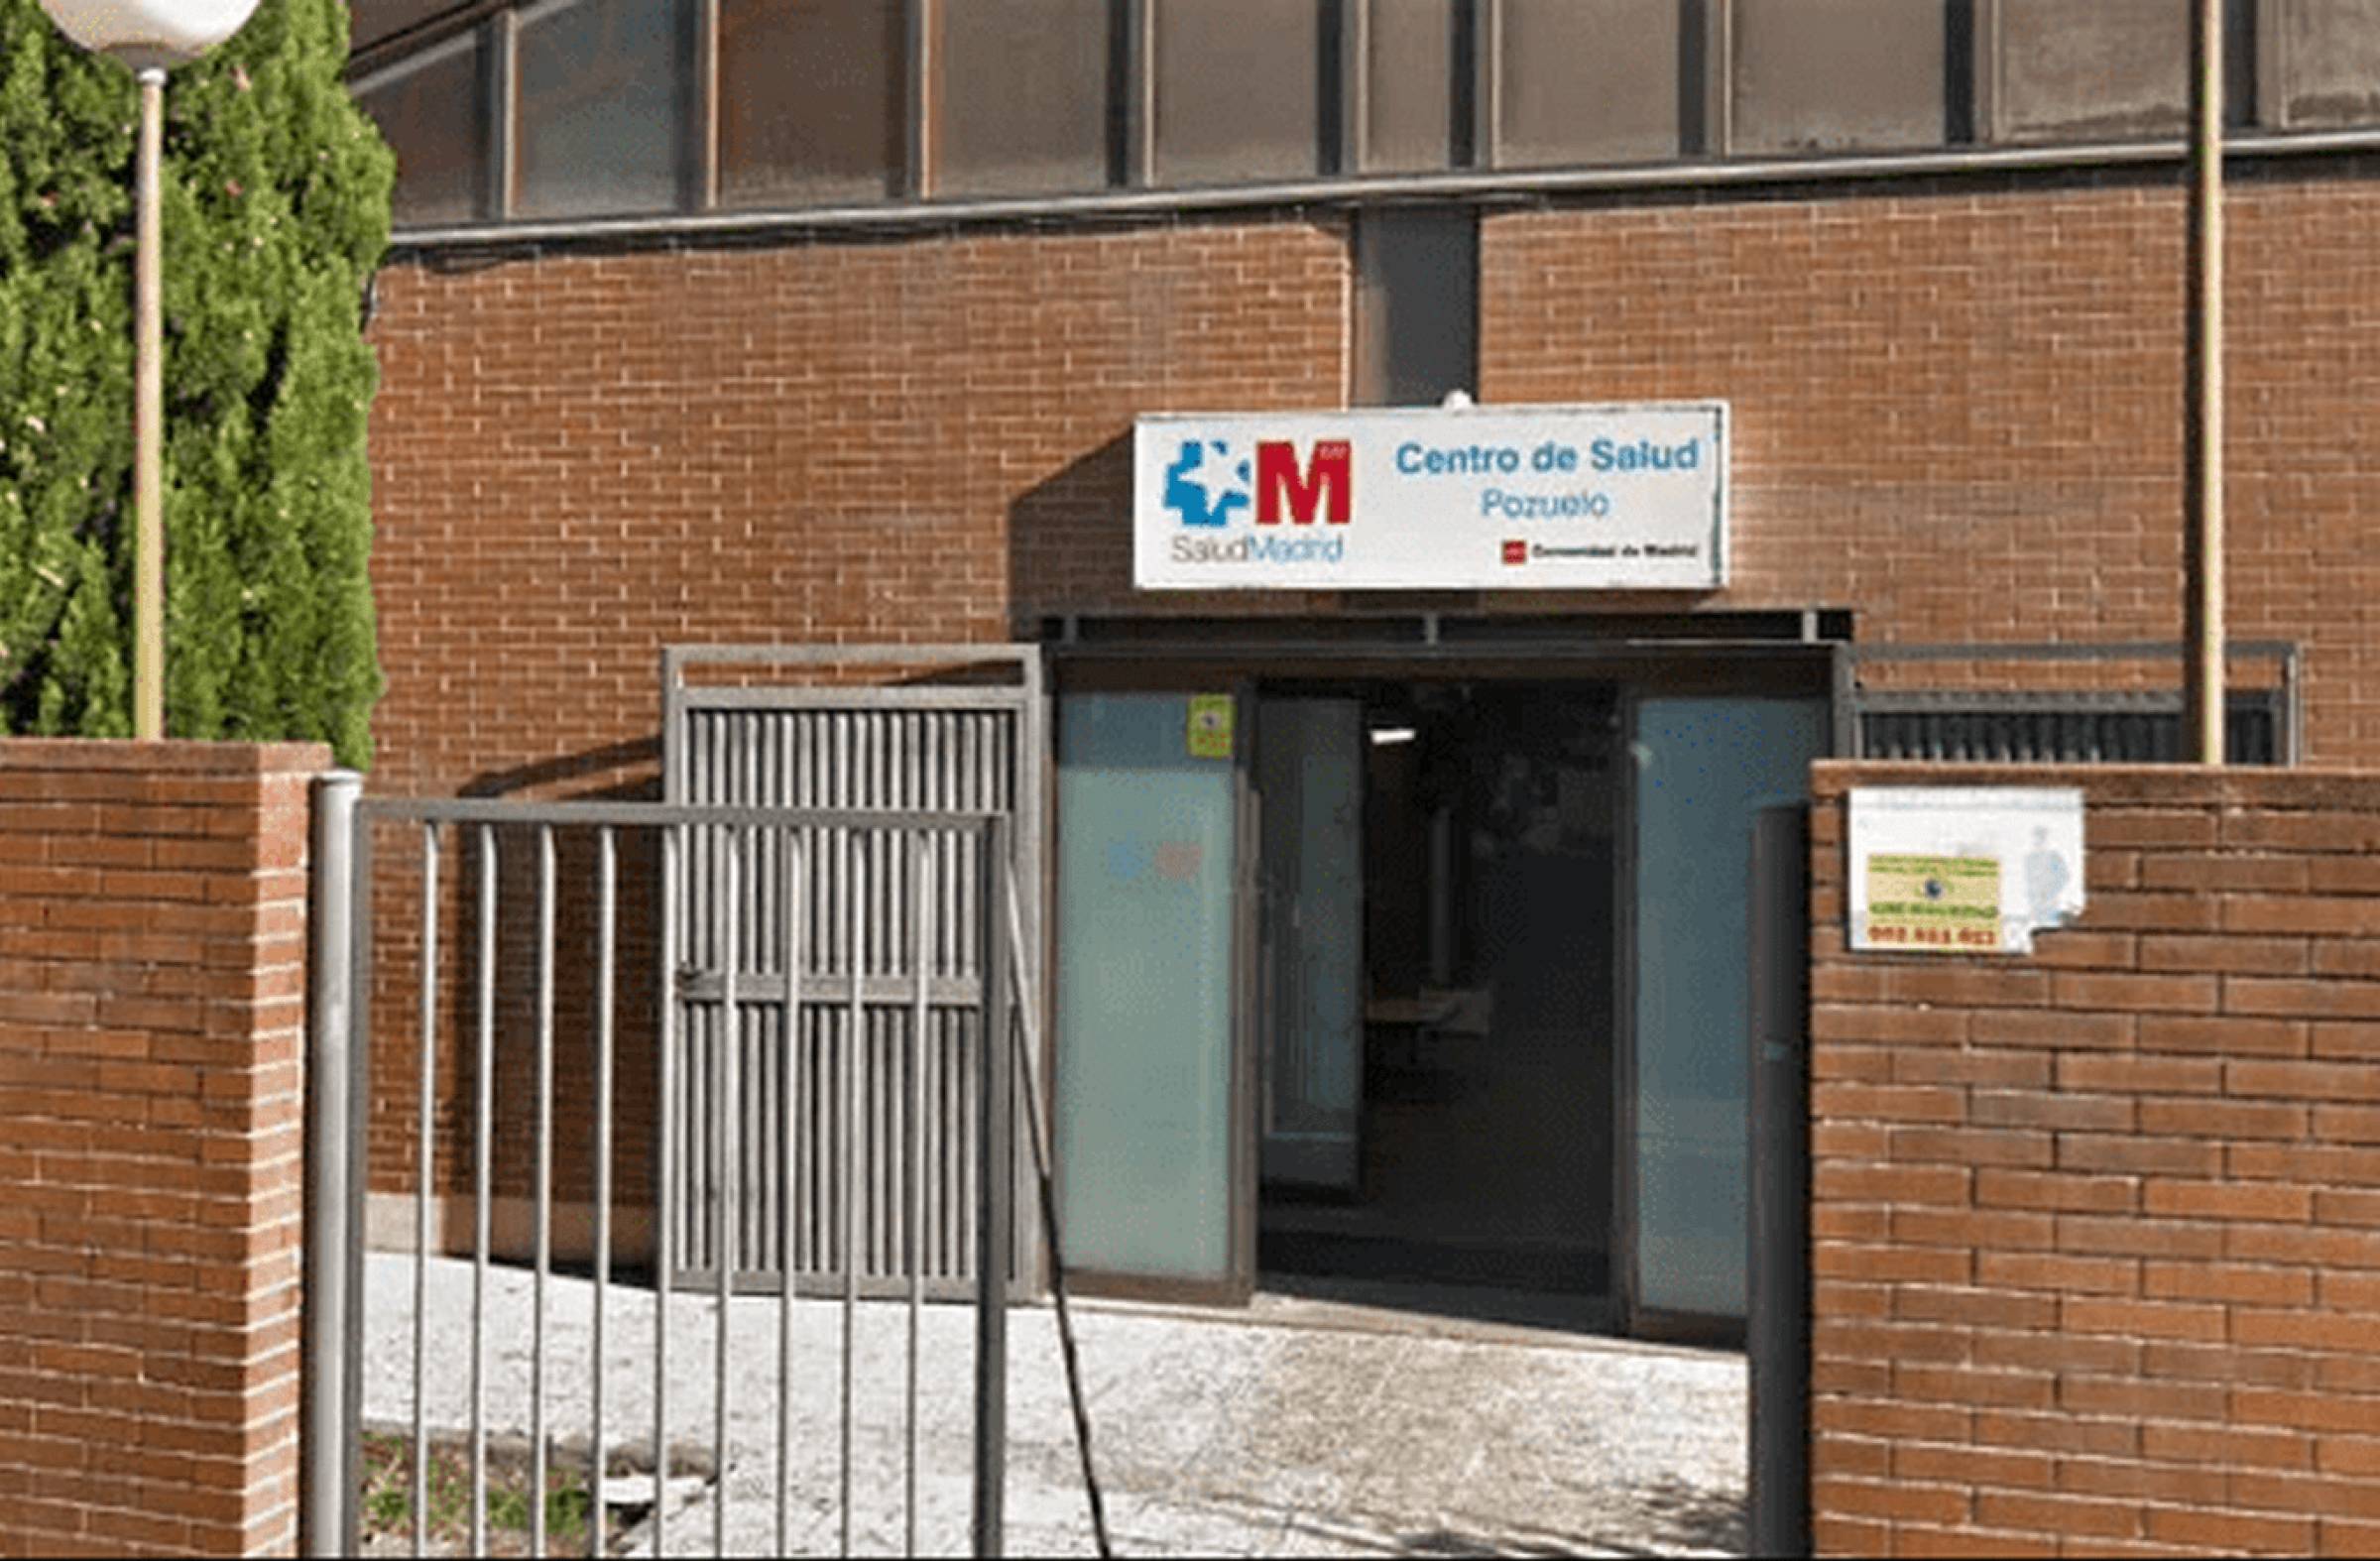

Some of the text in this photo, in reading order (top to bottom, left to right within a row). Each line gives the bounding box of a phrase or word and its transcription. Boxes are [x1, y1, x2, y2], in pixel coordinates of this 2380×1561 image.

[1395, 437, 1699, 474] Centro de Salud
[1256, 440, 1351, 525] M
[1481, 488, 1610, 518] Pozuelo
